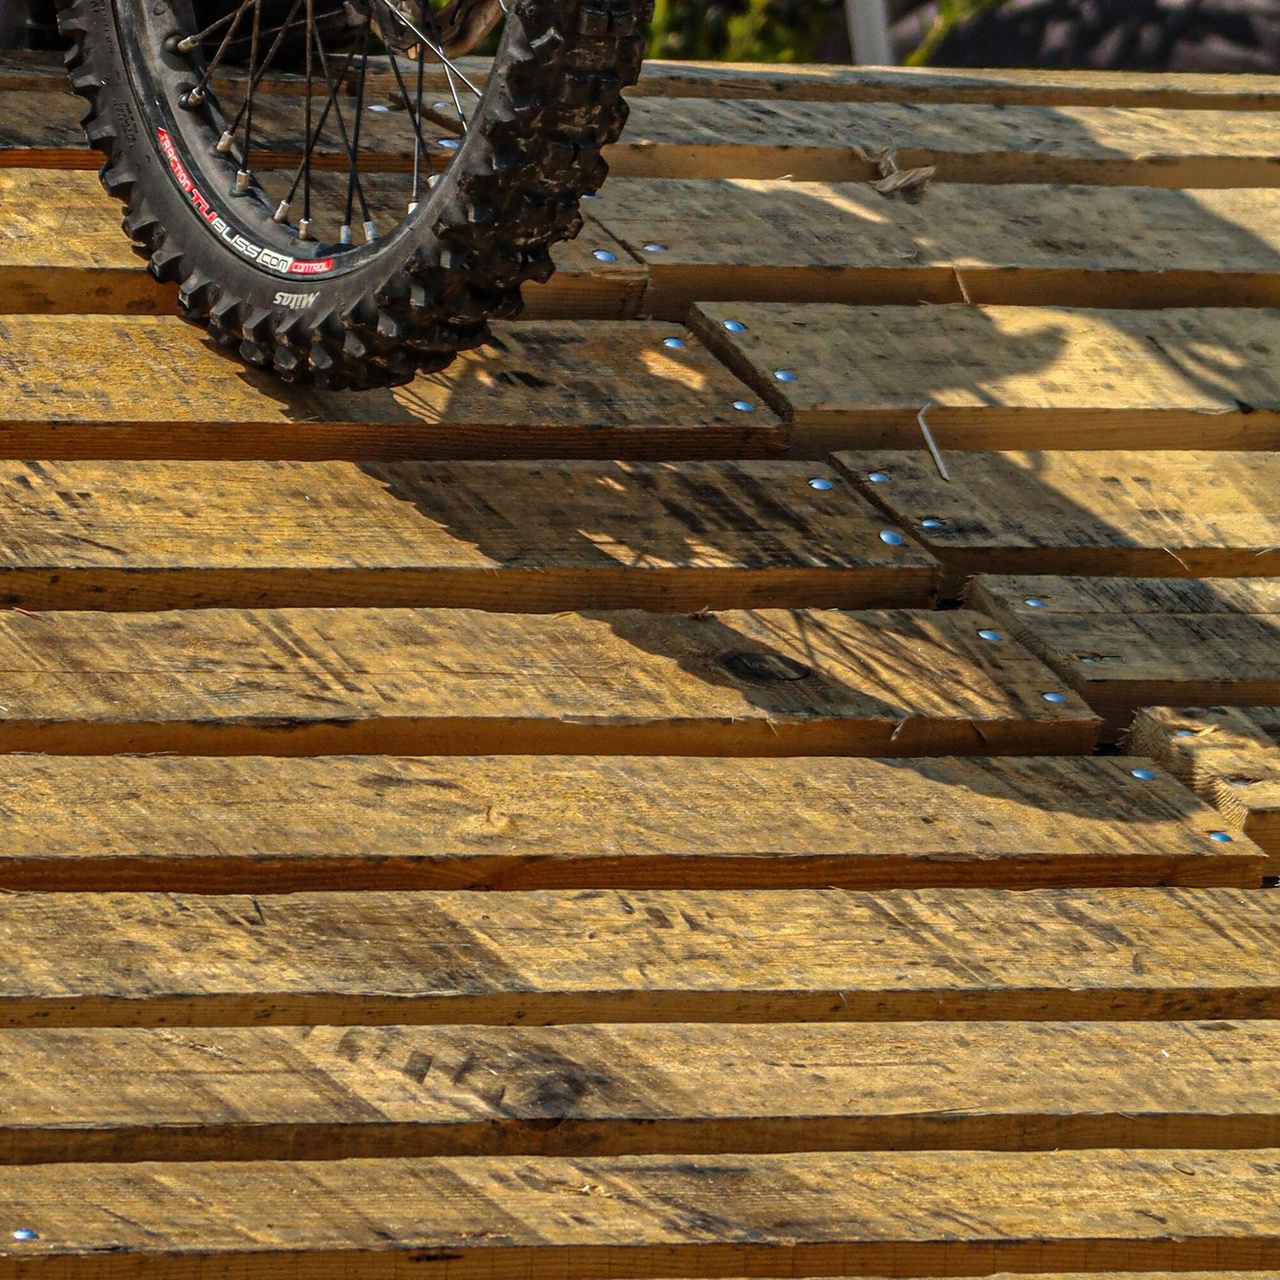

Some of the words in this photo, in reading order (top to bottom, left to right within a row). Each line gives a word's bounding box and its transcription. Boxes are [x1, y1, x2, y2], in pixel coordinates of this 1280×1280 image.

[158, 129, 193, 192] TRACTION
[291, 259, 332, 273] CONTROL
[273, 291, 319, 310] Mitas
